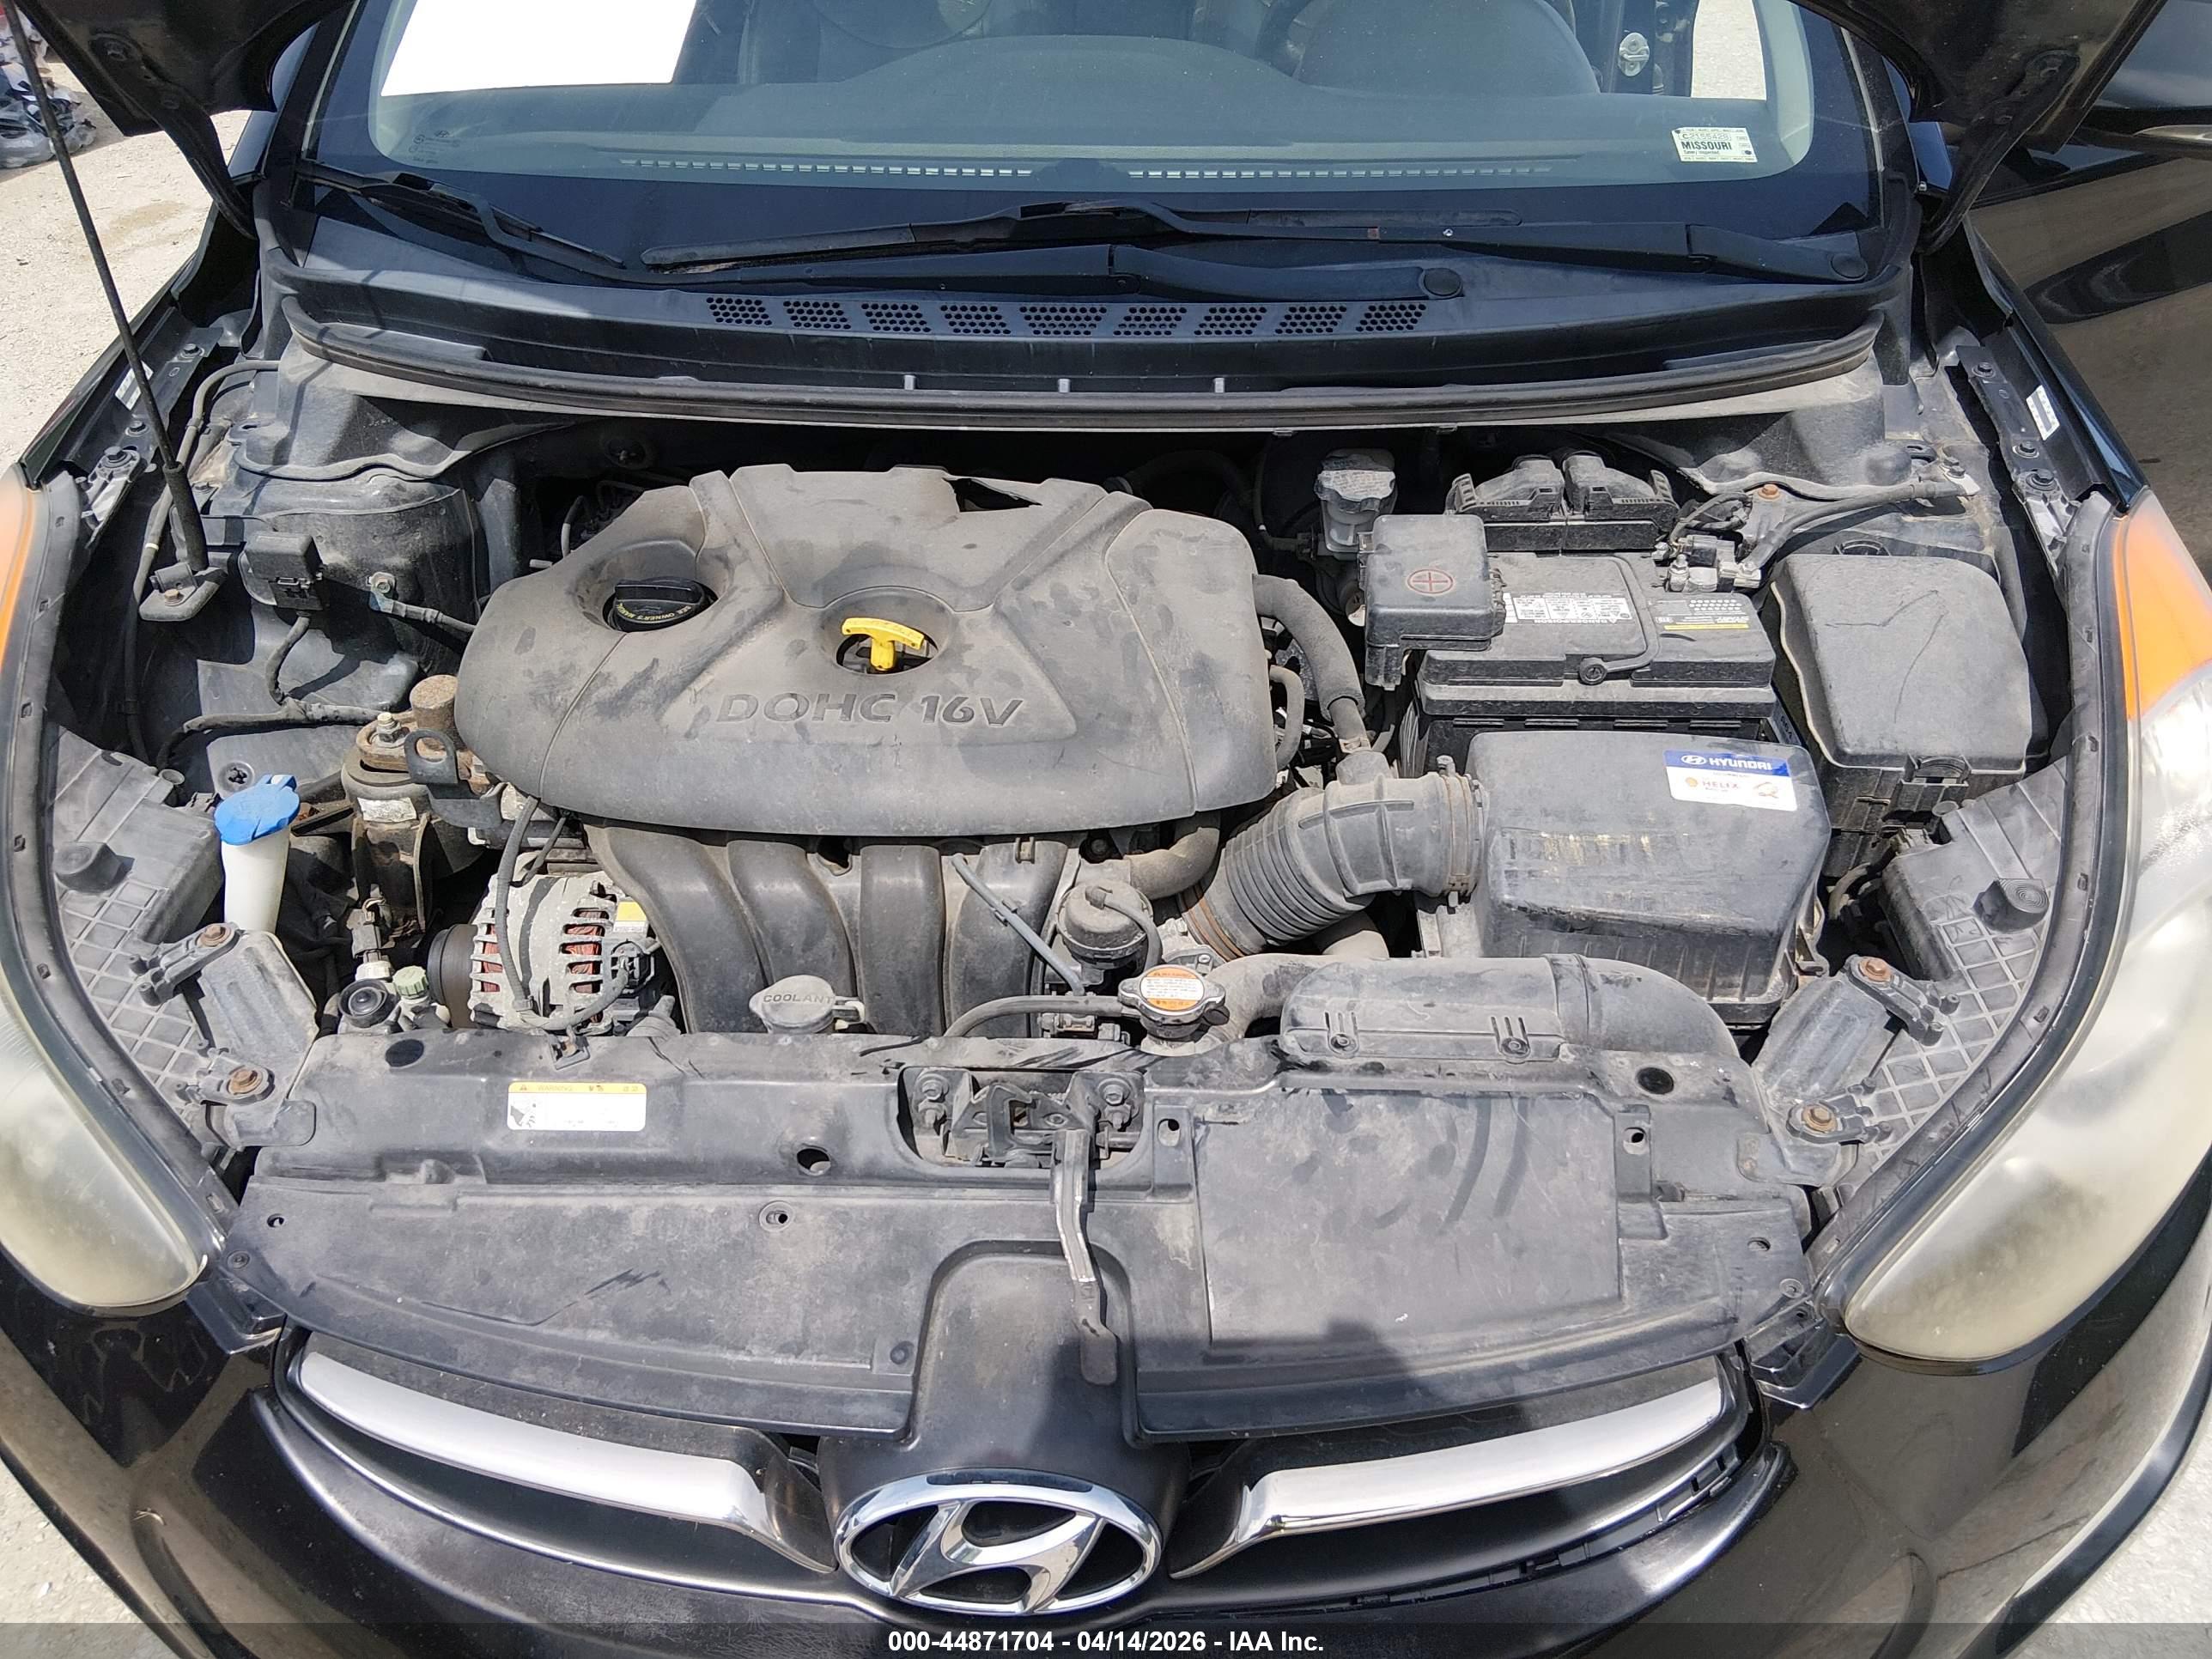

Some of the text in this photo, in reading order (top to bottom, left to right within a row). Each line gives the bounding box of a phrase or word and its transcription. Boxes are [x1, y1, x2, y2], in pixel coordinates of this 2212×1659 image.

[1680, 141, 1733, 150] MISSOURI
[676, 605, 692, 615] SEE
[636, 612, 675, 621] OWNER'S
[715, 692, 1024, 727] DOHC 16V
[1709, 757, 1773, 770] HYUNDAI
[1703, 781, 1739, 789] HELIX
[763, 994, 836, 1004] COOLANT
